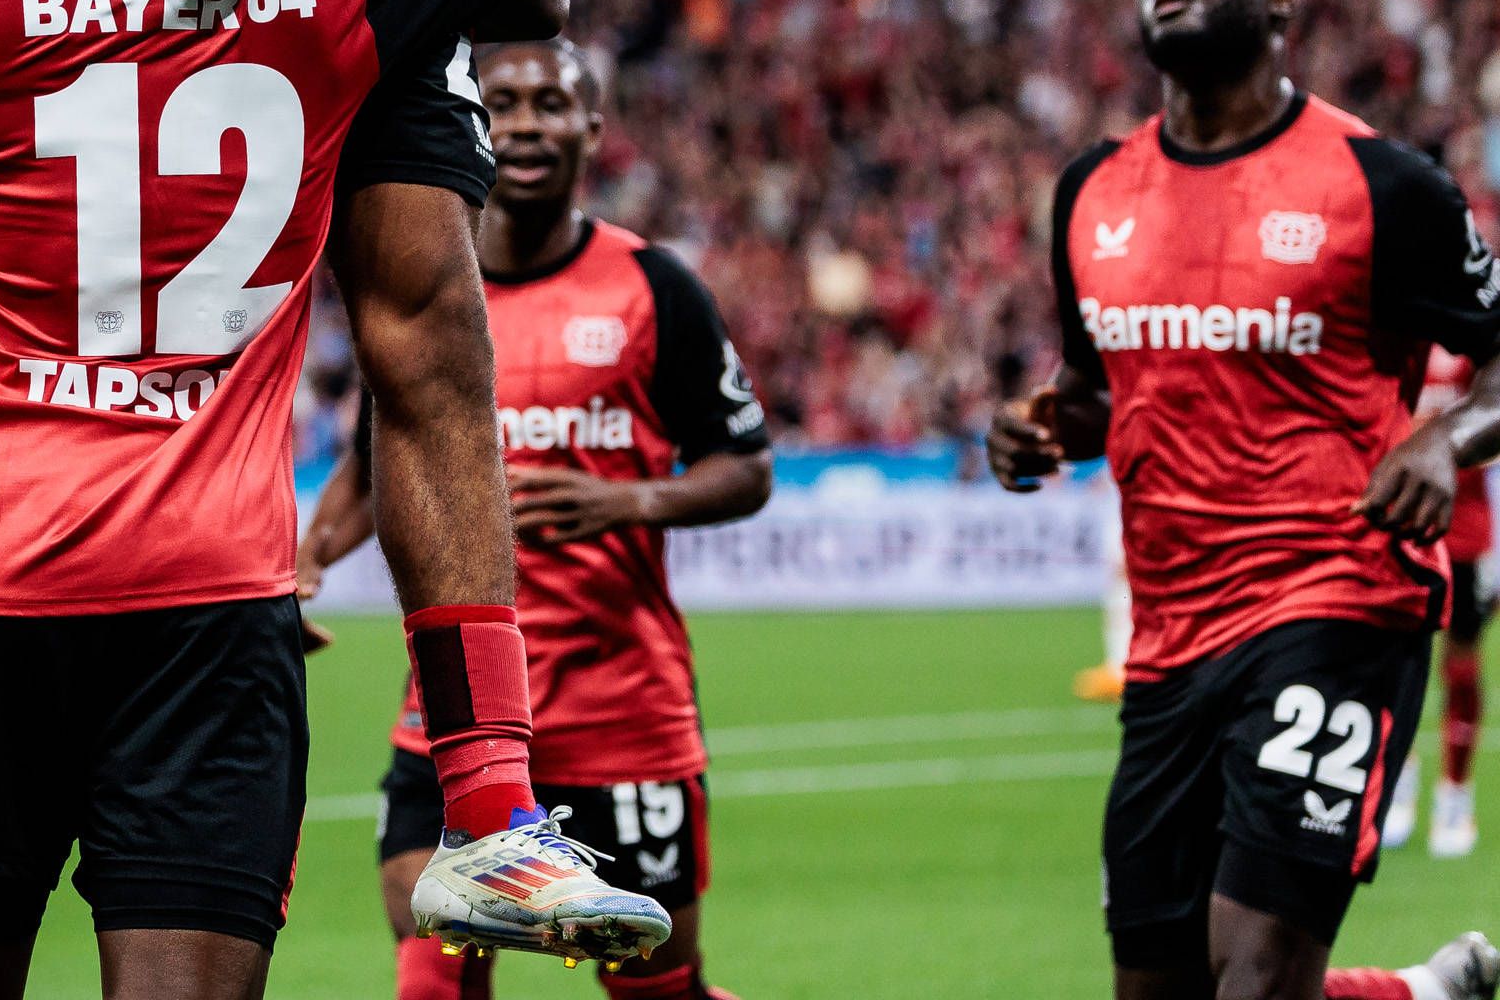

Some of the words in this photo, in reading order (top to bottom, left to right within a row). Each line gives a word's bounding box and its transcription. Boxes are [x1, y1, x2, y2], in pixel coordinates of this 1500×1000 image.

[33, 62, 305, 357] 12
[19, 358, 232, 422] TAPSO
[1257, 684, 1373, 794] 22
